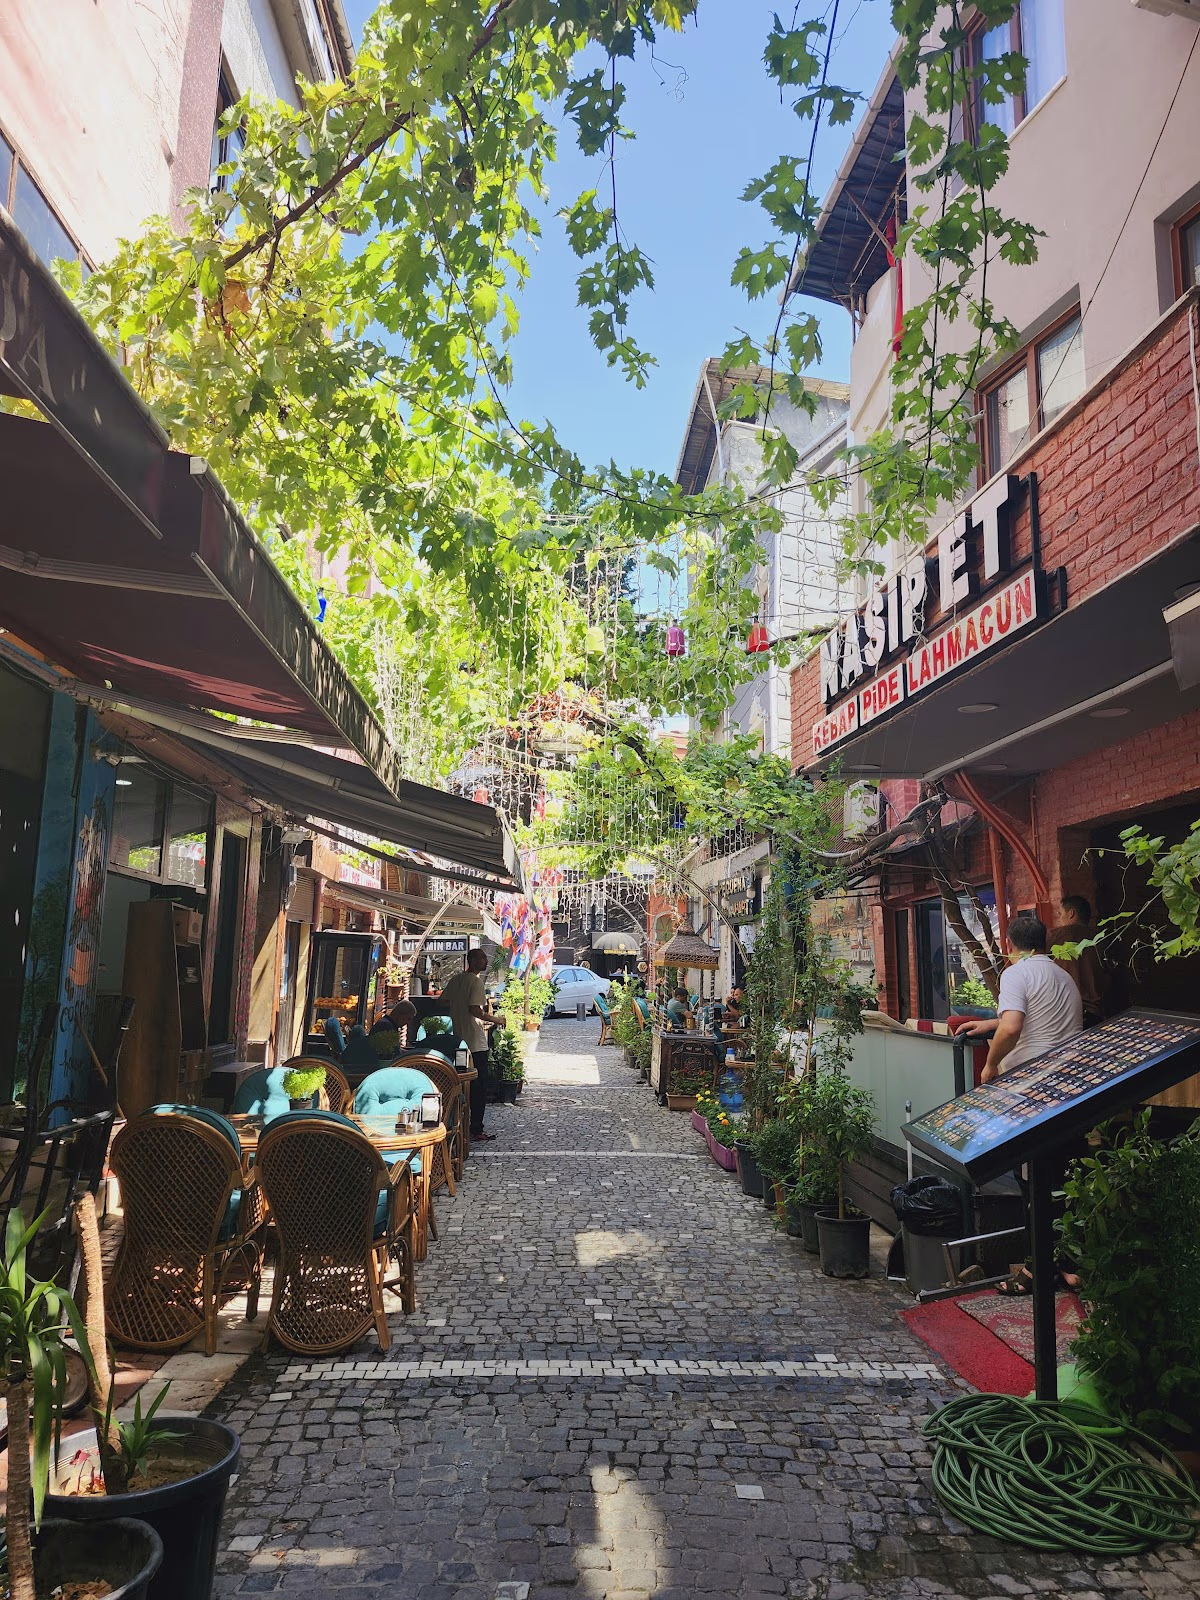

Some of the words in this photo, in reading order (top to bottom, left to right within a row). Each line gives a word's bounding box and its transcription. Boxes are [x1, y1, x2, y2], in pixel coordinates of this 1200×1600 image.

[938, 474, 1009, 613] ET
[813, 700, 856, 751] KEBAP
[907, 576, 1032, 692] LAHMACUN
[445, 941, 464, 951] BAR
